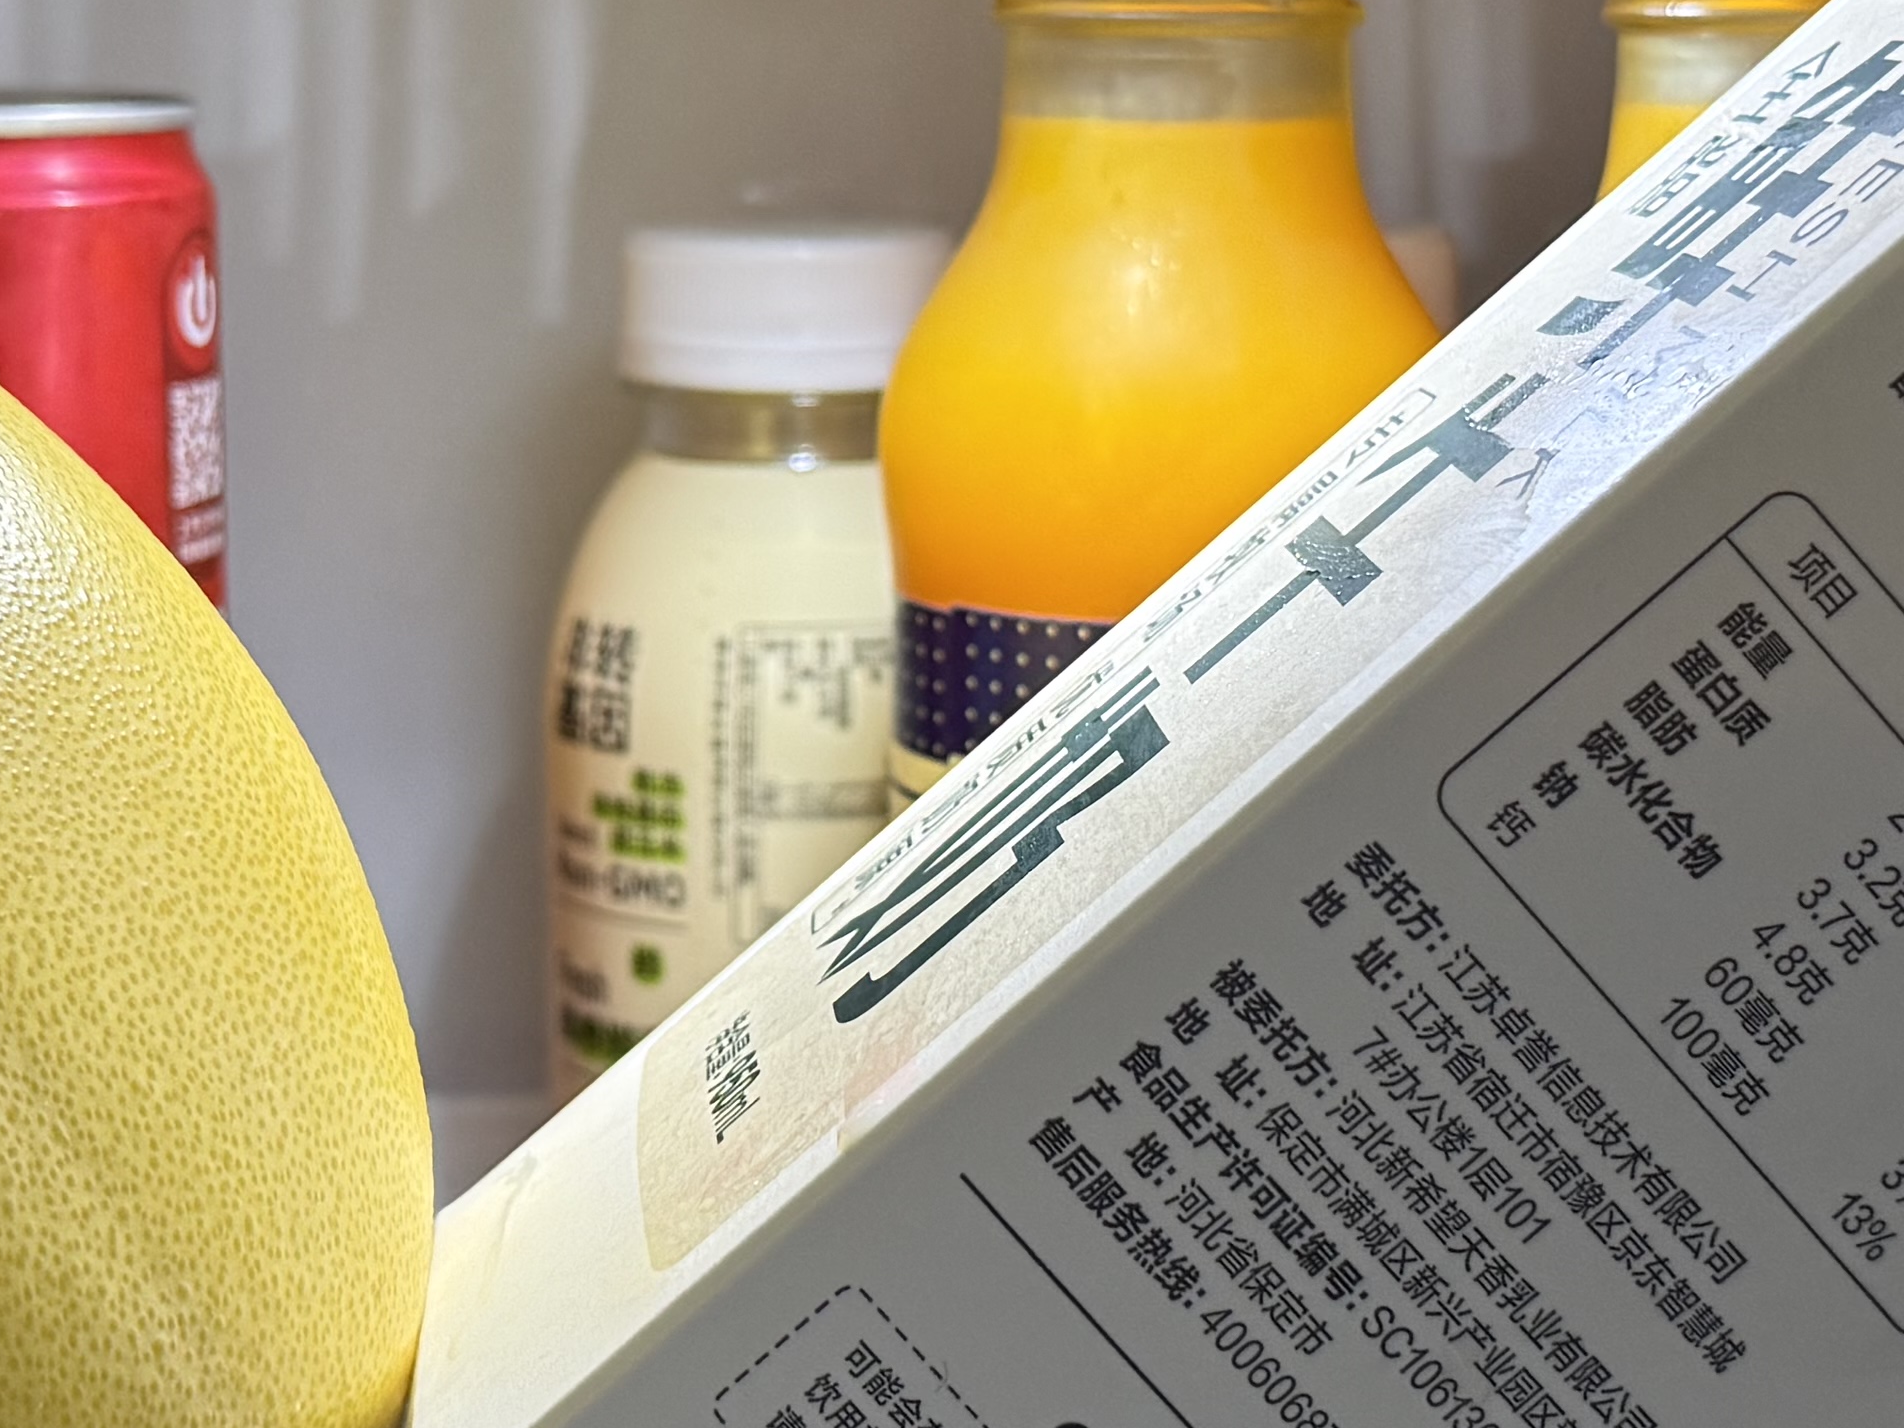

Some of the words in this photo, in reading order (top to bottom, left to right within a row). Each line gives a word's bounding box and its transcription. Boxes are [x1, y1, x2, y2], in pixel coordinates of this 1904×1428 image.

[1631, 41, 1840, 217] 全脂
[1718, 602, 1793, 680] 能量
[1788, 543, 1858, 619] 项目
[1671, 640, 1771, 746] 蛋白质
[1533, 761, 1578, 808] 钠
[1705, 957, 1804, 1063] 60毫克
[1579, 721, 1722, 879] 碳水化合物
[1753, 923, 1834, 1006] 4.8克
[1624, 681, 1697, 756] 脂肪
[1797, 878, 1879, 965] 3.7克
[1353, 1026, 1551, 1243] 7#办公楼1层101
[1487, 801, 1536, 847] 钙
[1661, 999, 1770, 1116] 100毫克
[1832, 1194, 1896, 1261] 13%
